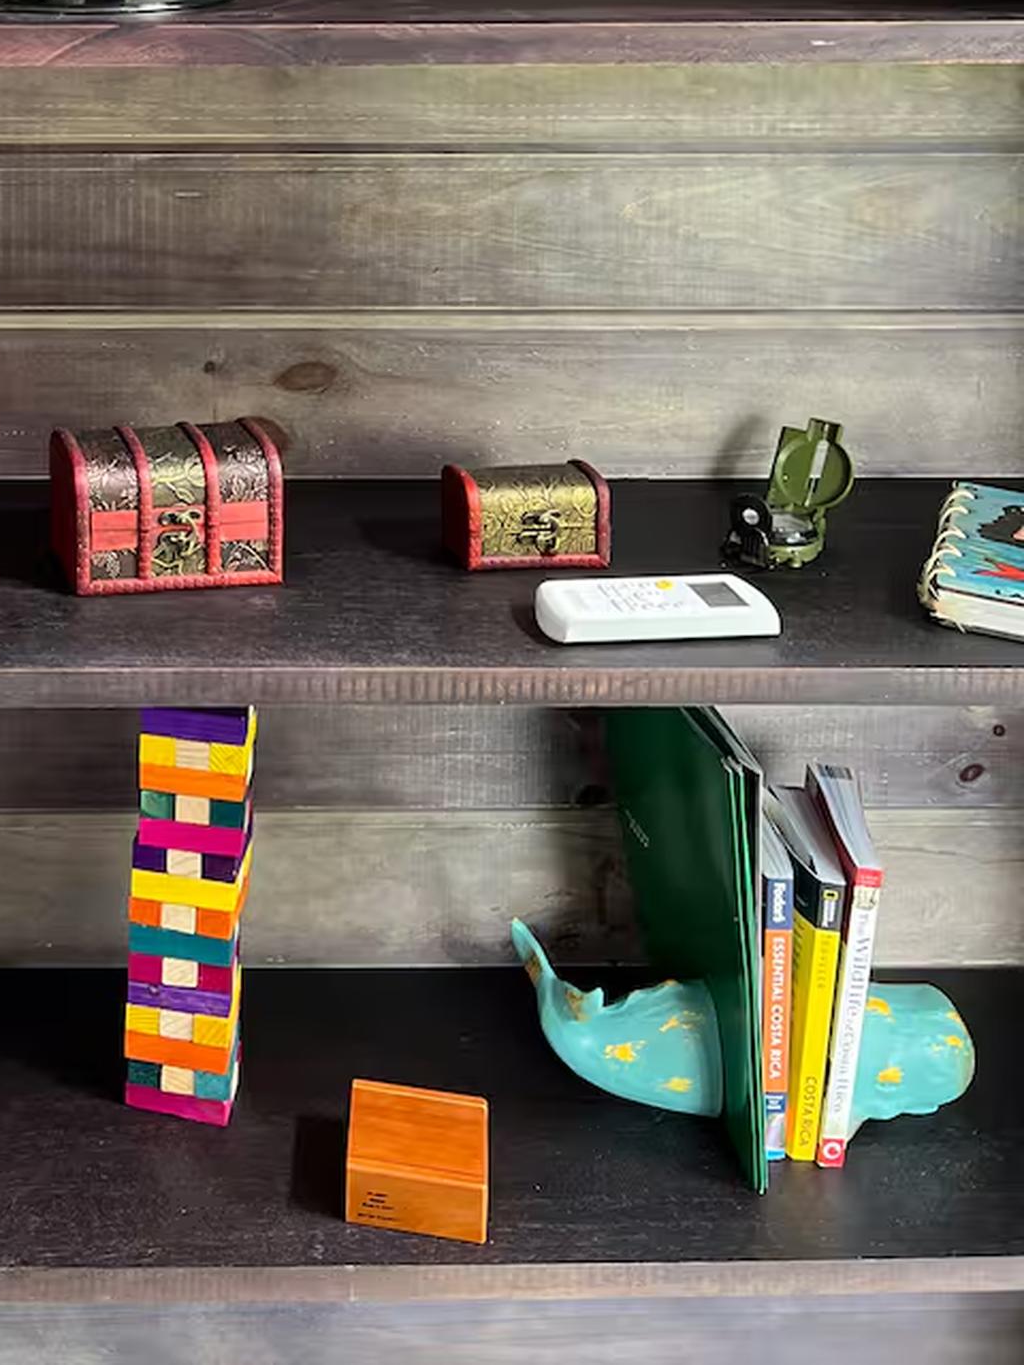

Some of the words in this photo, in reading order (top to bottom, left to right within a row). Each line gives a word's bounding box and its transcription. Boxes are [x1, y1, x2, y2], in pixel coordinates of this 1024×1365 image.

[771, 937, 786, 1001] ESSENTIAL
[847, 937, 870, 1016] Wildlife
[769, 1004, 784, 1045] COSTA
[768, 1049, 782, 1079] RICA
[803, 1076, 818, 1115] COSTA
[799, 1118, 814, 1146] RICA
